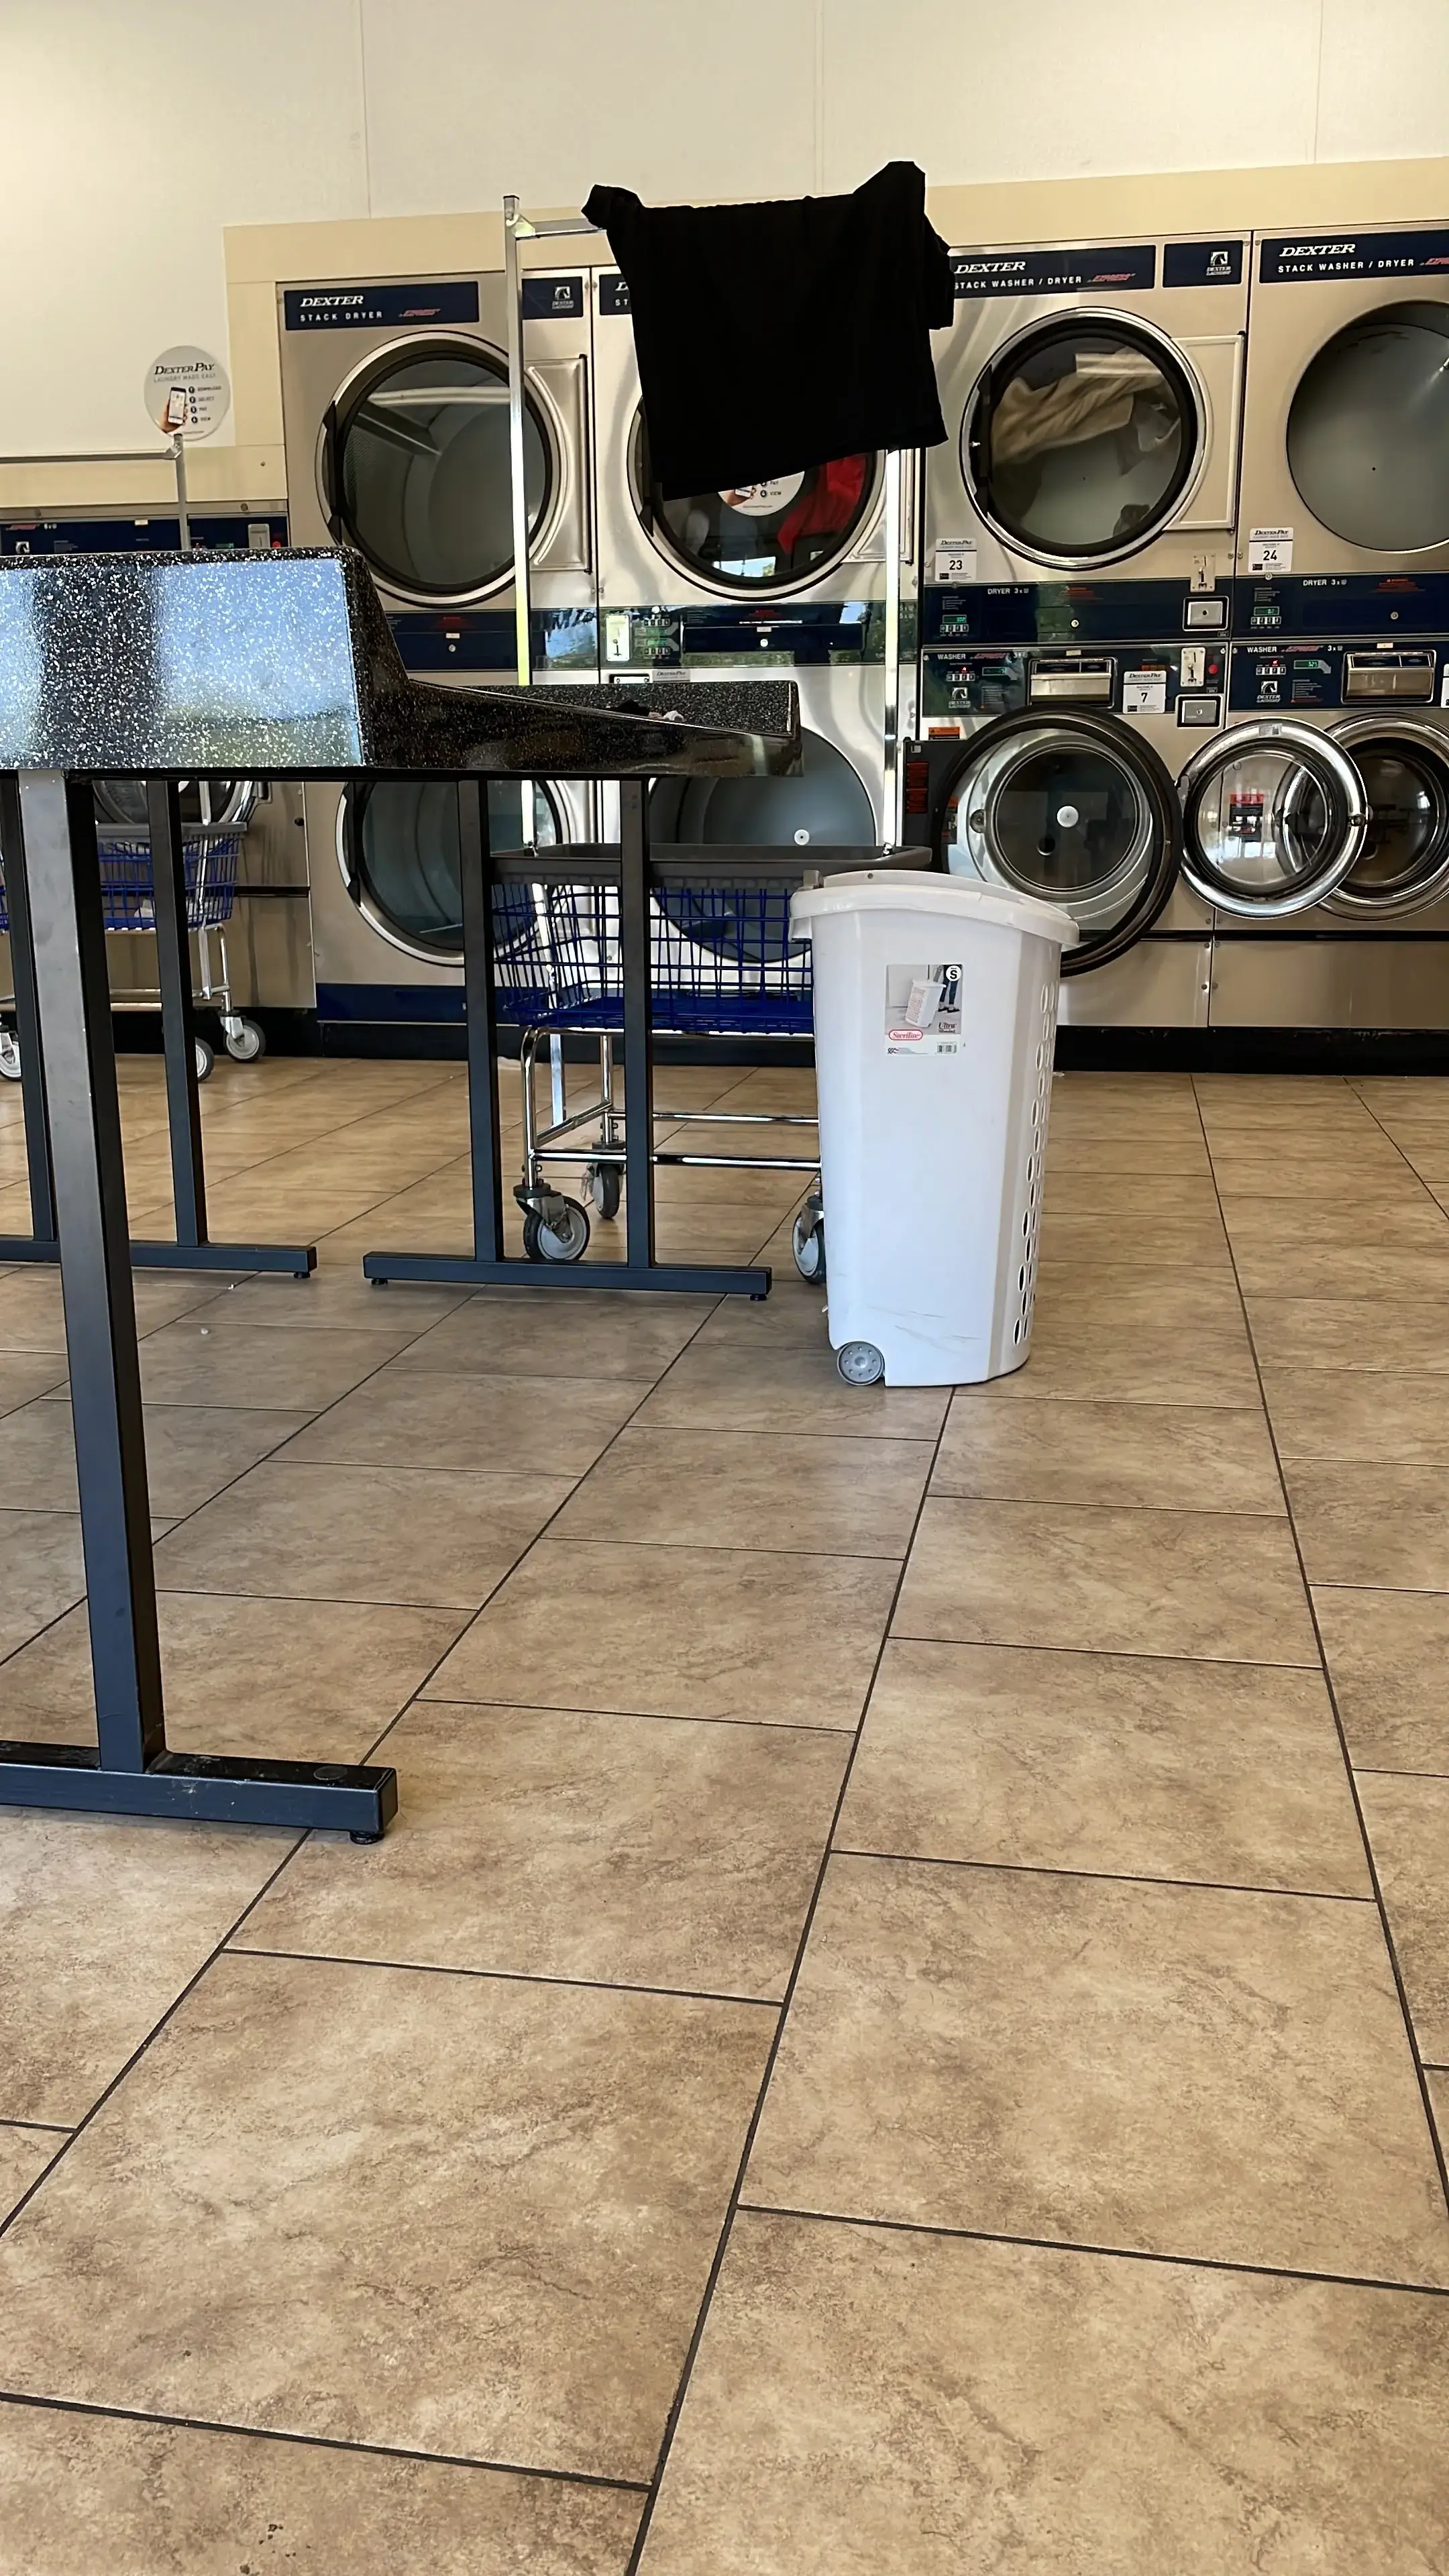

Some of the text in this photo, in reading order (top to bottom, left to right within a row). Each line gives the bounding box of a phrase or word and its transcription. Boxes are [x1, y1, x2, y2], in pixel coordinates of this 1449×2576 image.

[1279, 244, 1356, 257] DEXTER
[953, 261, 1026, 274] DEXTER
[1278, 264, 1313, 273] STACK
[1319, 262, 1364, 271] WASHER
[1378, 259, 1414, 268] DRYER
[954, 280, 987, 290] STACK
[992, 278, 1034, 287] WASHER
[1047, 276, 1082, 285] DRYER
[300, 295, 364, 307] DEXTER
[300, 311, 382, 323] STACK DRYER
[1263, 549, 1277, 561] 24
[949, 559, 963, 570] 23
[1140, 692, 1148, 703] 7
[950, 969, 957, 979] S
